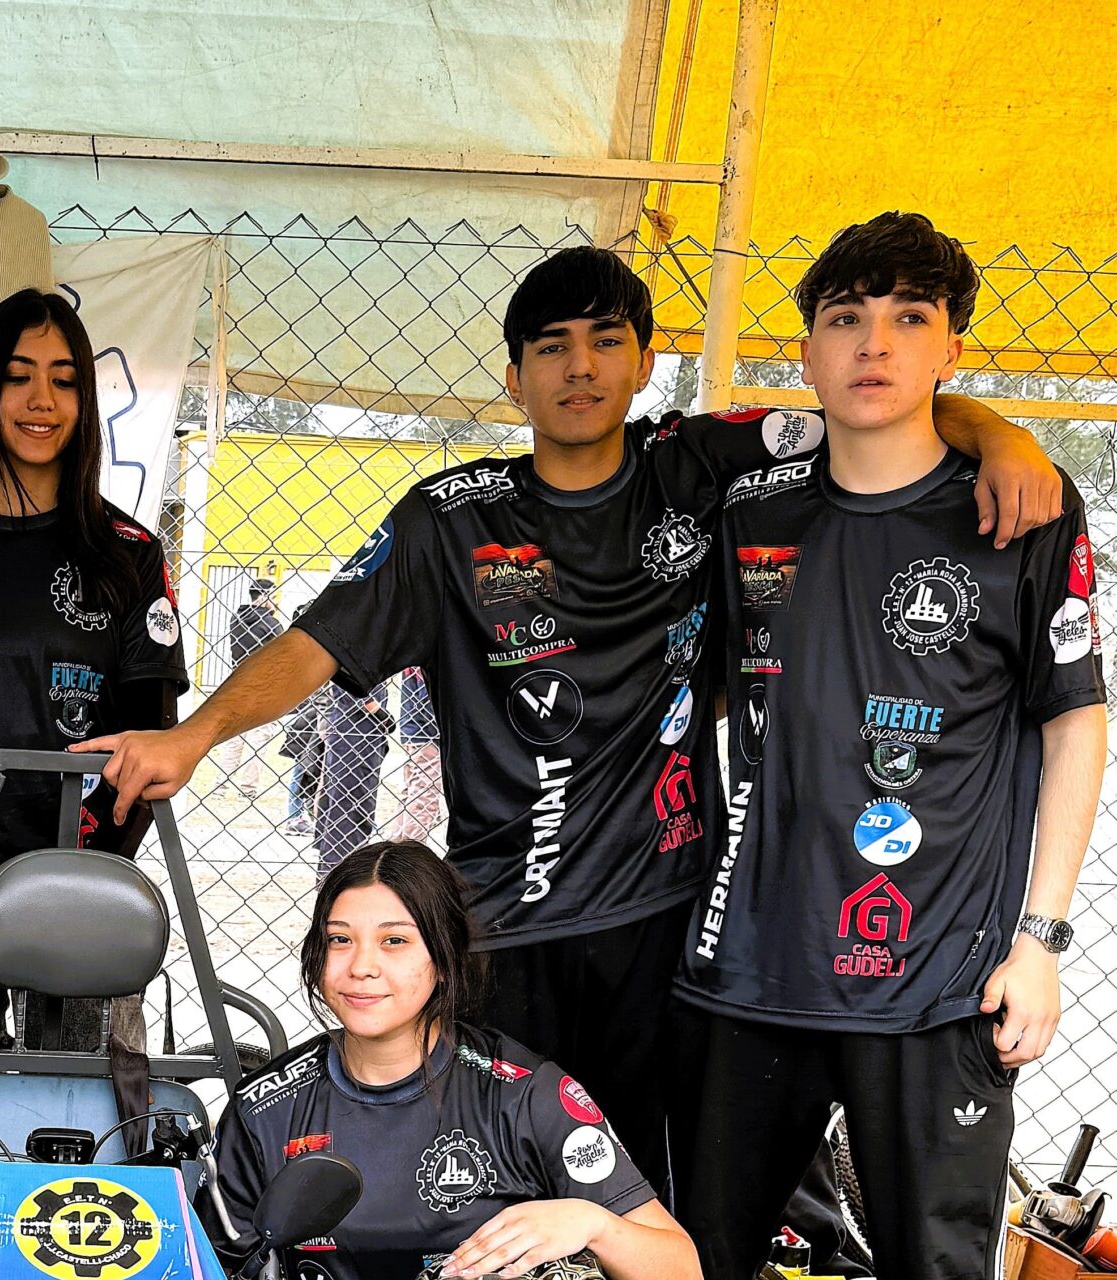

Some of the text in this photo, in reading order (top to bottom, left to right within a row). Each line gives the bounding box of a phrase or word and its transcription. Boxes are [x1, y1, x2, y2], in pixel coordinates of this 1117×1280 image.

[924, 625, 958, 645] CASTELLI
[487, 636, 576, 662] MULTICOMPRA
[51, 667, 105, 693] FUERTE
[864, 699, 945, 732] FUERTE
[859, 721, 941, 744] Esperanza
[666, 813, 692, 830] CASA
[859, 814, 893, 829] JO
[658, 816, 704, 854] GUDELJ
[883, 839, 912, 855] DI
[695, 780, 754, 961] HERMANN
[851, 943, 891, 958] CASA
[833, 955, 906, 978] GUDELJ
[61, 1210, 112, 1247] 12
